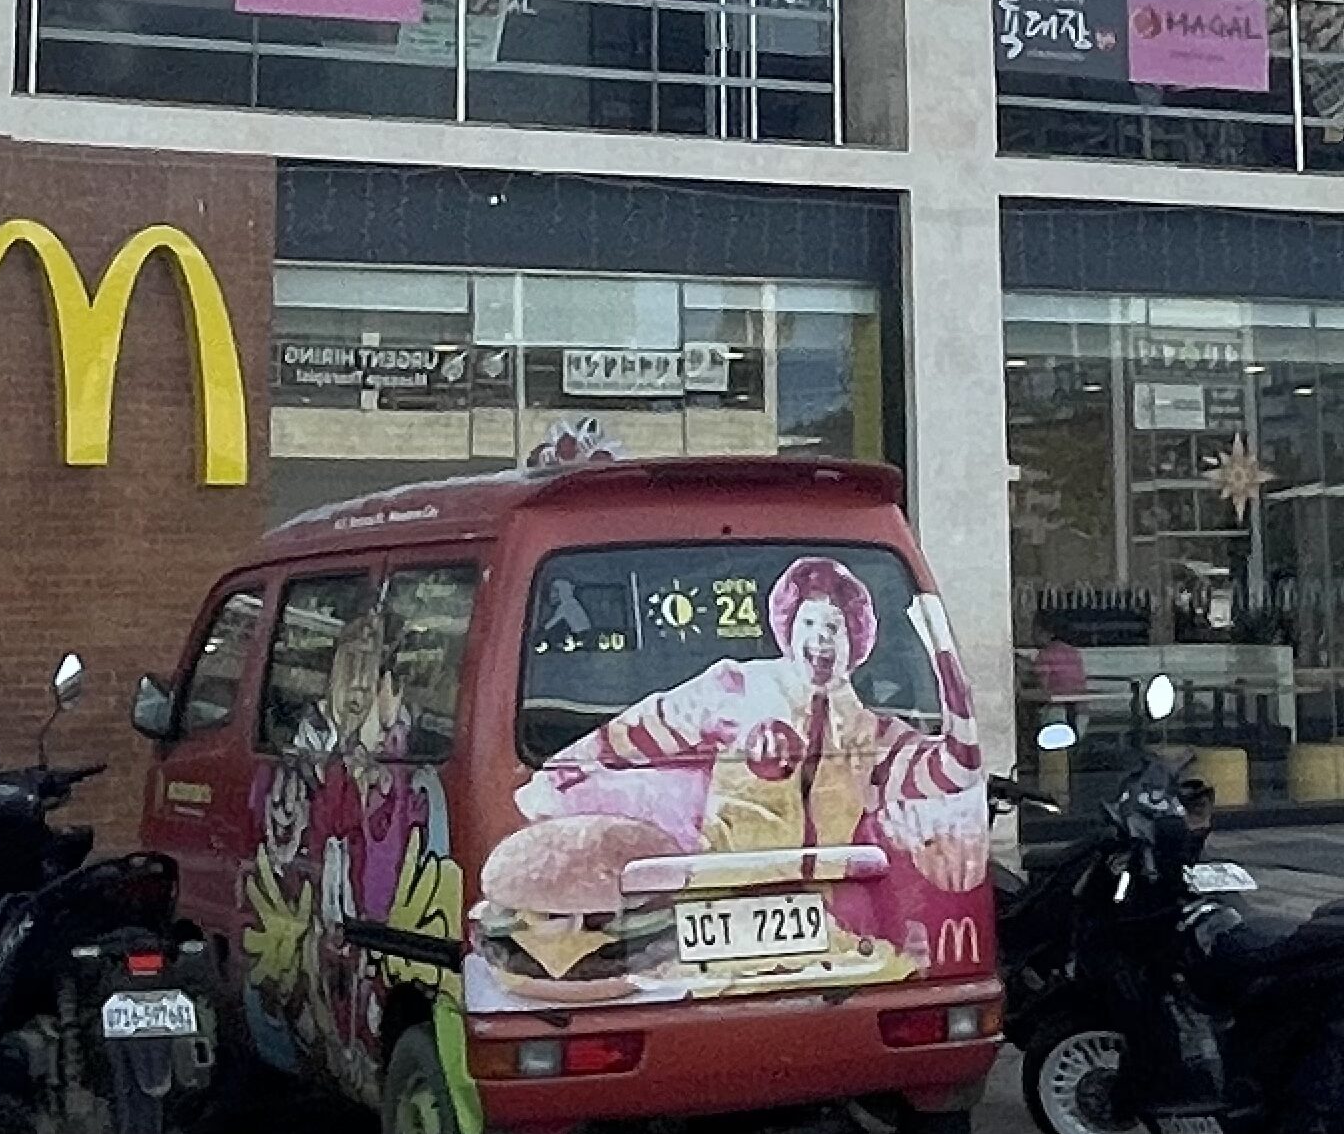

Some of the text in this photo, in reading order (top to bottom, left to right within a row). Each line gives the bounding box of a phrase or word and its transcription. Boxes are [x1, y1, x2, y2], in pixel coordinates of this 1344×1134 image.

[1166, 10, 1263, 40] MAGAL
[713, 578, 757, 595] OPEN
[715, 596, 758, 626] 24
[684, 906, 822, 948] JCT 7219
